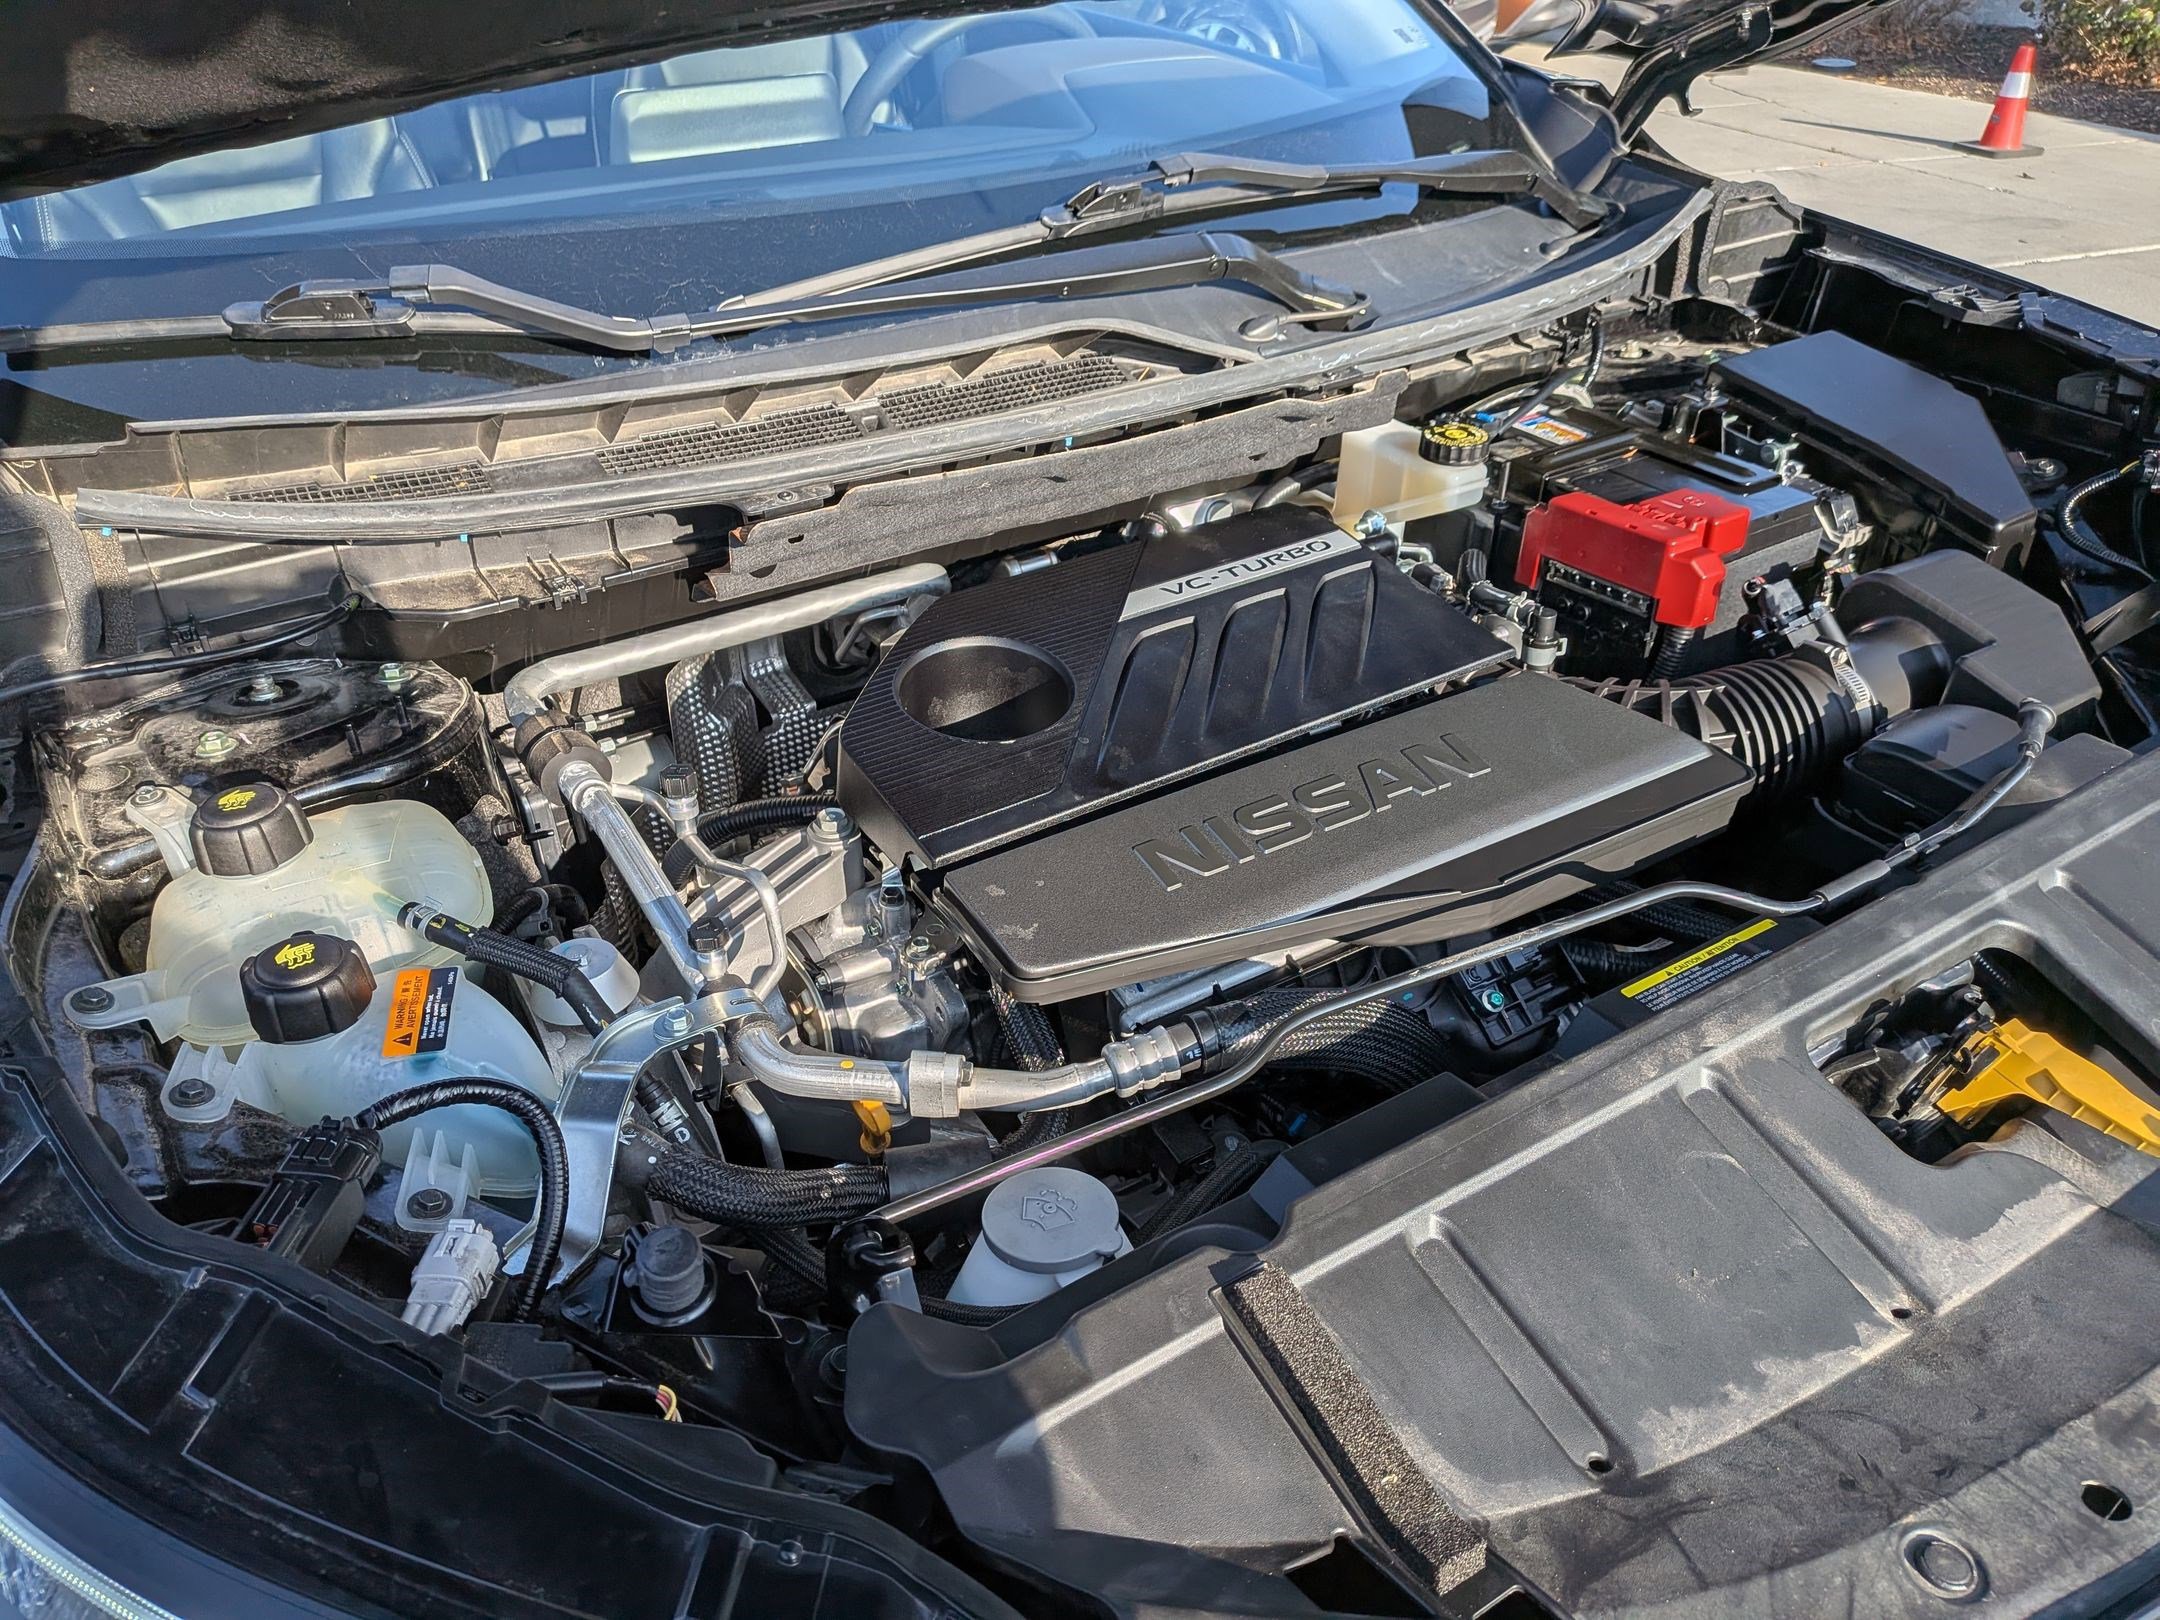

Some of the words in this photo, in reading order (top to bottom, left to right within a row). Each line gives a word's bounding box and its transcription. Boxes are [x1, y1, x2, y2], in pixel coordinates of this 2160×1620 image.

[1160, 540, 1332, 595] VC-TURBO
[1131, 732, 1492, 892] NISSAN
[1673, 956, 1703, 972] CAUTION
[1705, 937, 1741, 956] ATTENTION
[394, 998, 409, 1030] WARNING
[406, 976, 424, 1028] AVERTISSEMENT
